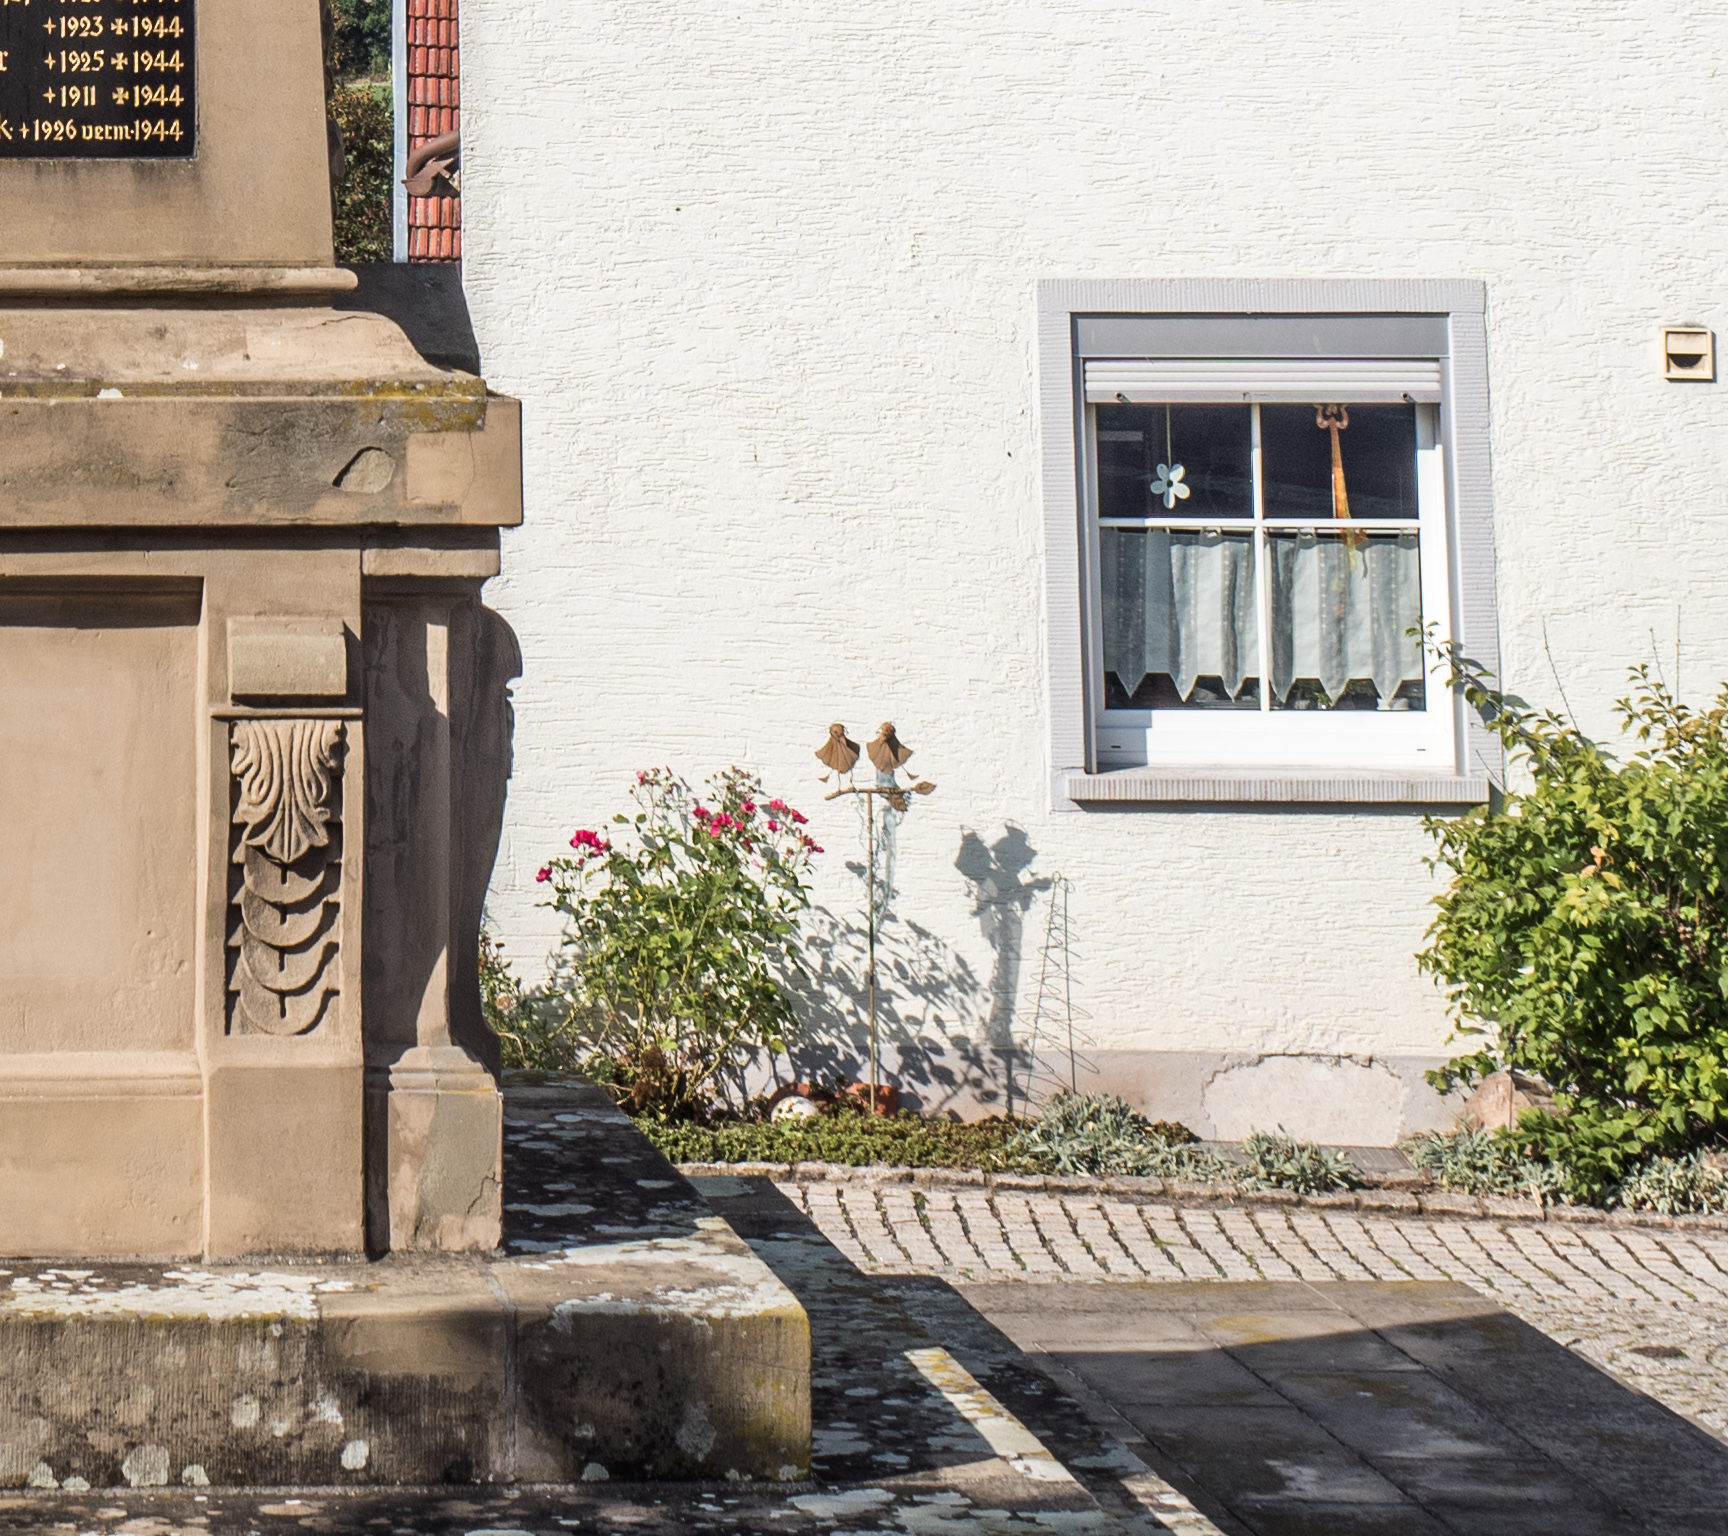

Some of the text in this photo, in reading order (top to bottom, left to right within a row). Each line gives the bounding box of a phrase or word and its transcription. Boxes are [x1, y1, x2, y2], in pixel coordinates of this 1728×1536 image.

[59, 15, 104, 39] 1923
[131, 15, 185, 39] 1944
[59, 49, 105, 74] 1925
[132, 49, 185, 74] 1944
[60, 84, 97, 108] 1911
[133, 83, 185, 108] 1944
[33, 118, 78, 142] 1926
[134, 118, 184, 142] 1944
